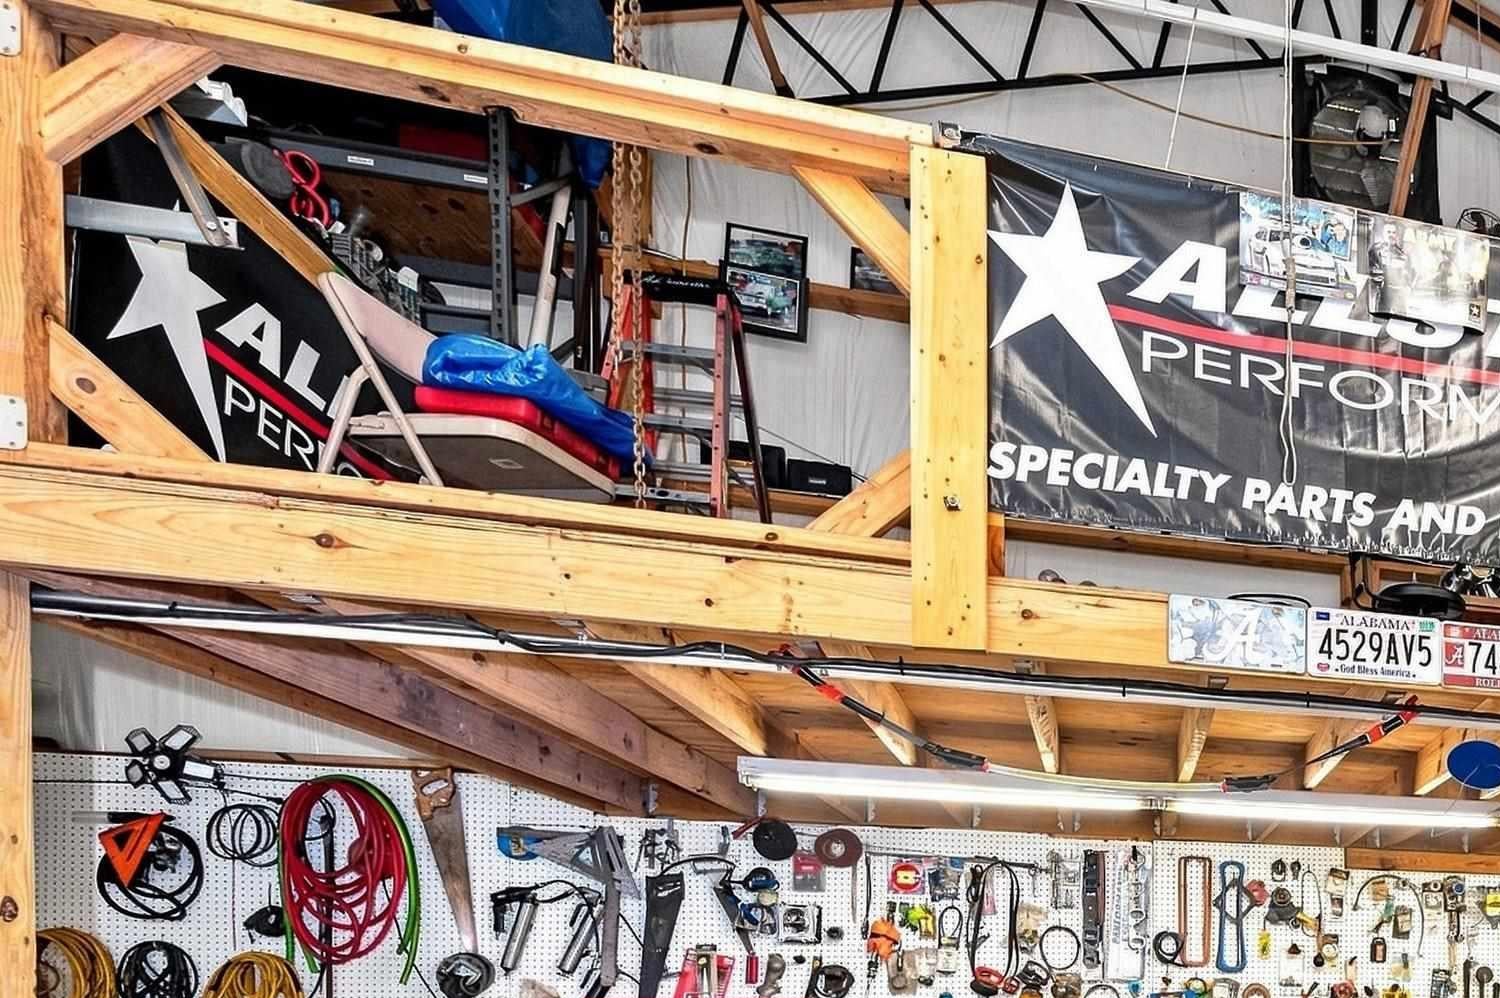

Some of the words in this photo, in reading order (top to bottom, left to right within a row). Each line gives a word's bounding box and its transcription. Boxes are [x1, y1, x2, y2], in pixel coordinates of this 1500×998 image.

[987, 441, 1232, 504] SPECIALTY
[1242, 477, 1376, 527] PARTS
[1389, 498, 1486, 536] AND
[1340, 615, 1410, 631] ALABAMA
[1318, 627, 1432, 668] 4529AV5
[1340, 665, 1355, 674] God
[1357, 666, 1378, 676] Bless
[1380, 667, 1411, 679] America
